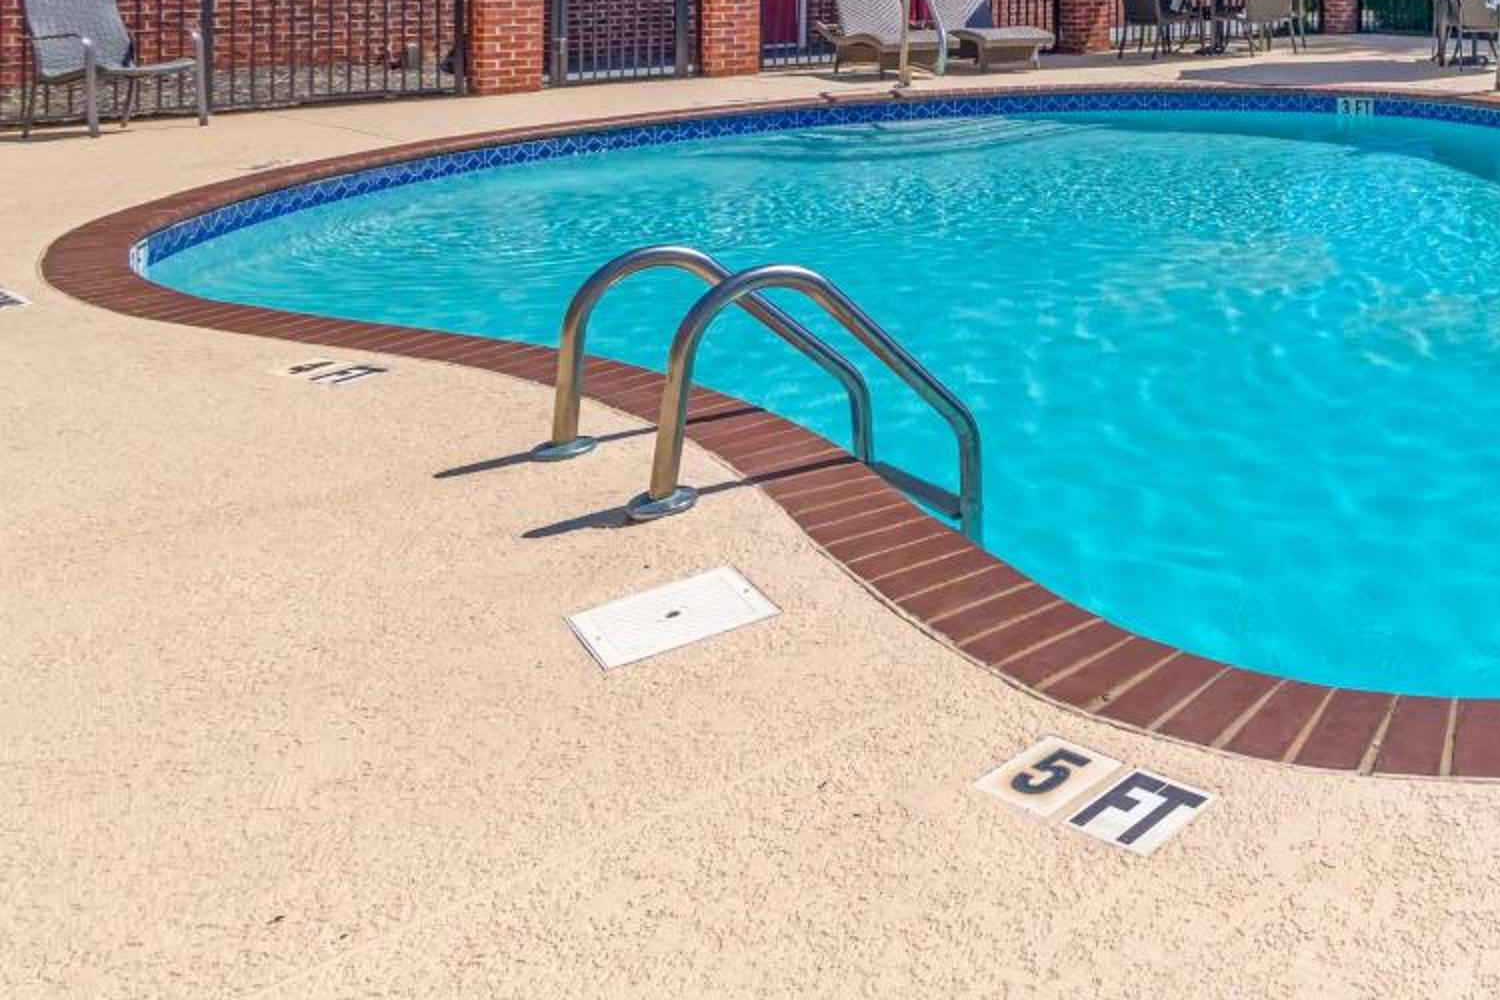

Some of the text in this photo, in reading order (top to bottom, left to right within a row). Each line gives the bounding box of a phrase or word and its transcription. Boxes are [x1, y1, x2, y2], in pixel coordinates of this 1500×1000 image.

[1355, 99, 1370, 116] FT
[308, 364, 389, 384] FT
[1010, 747, 1209, 845] 5 FT
